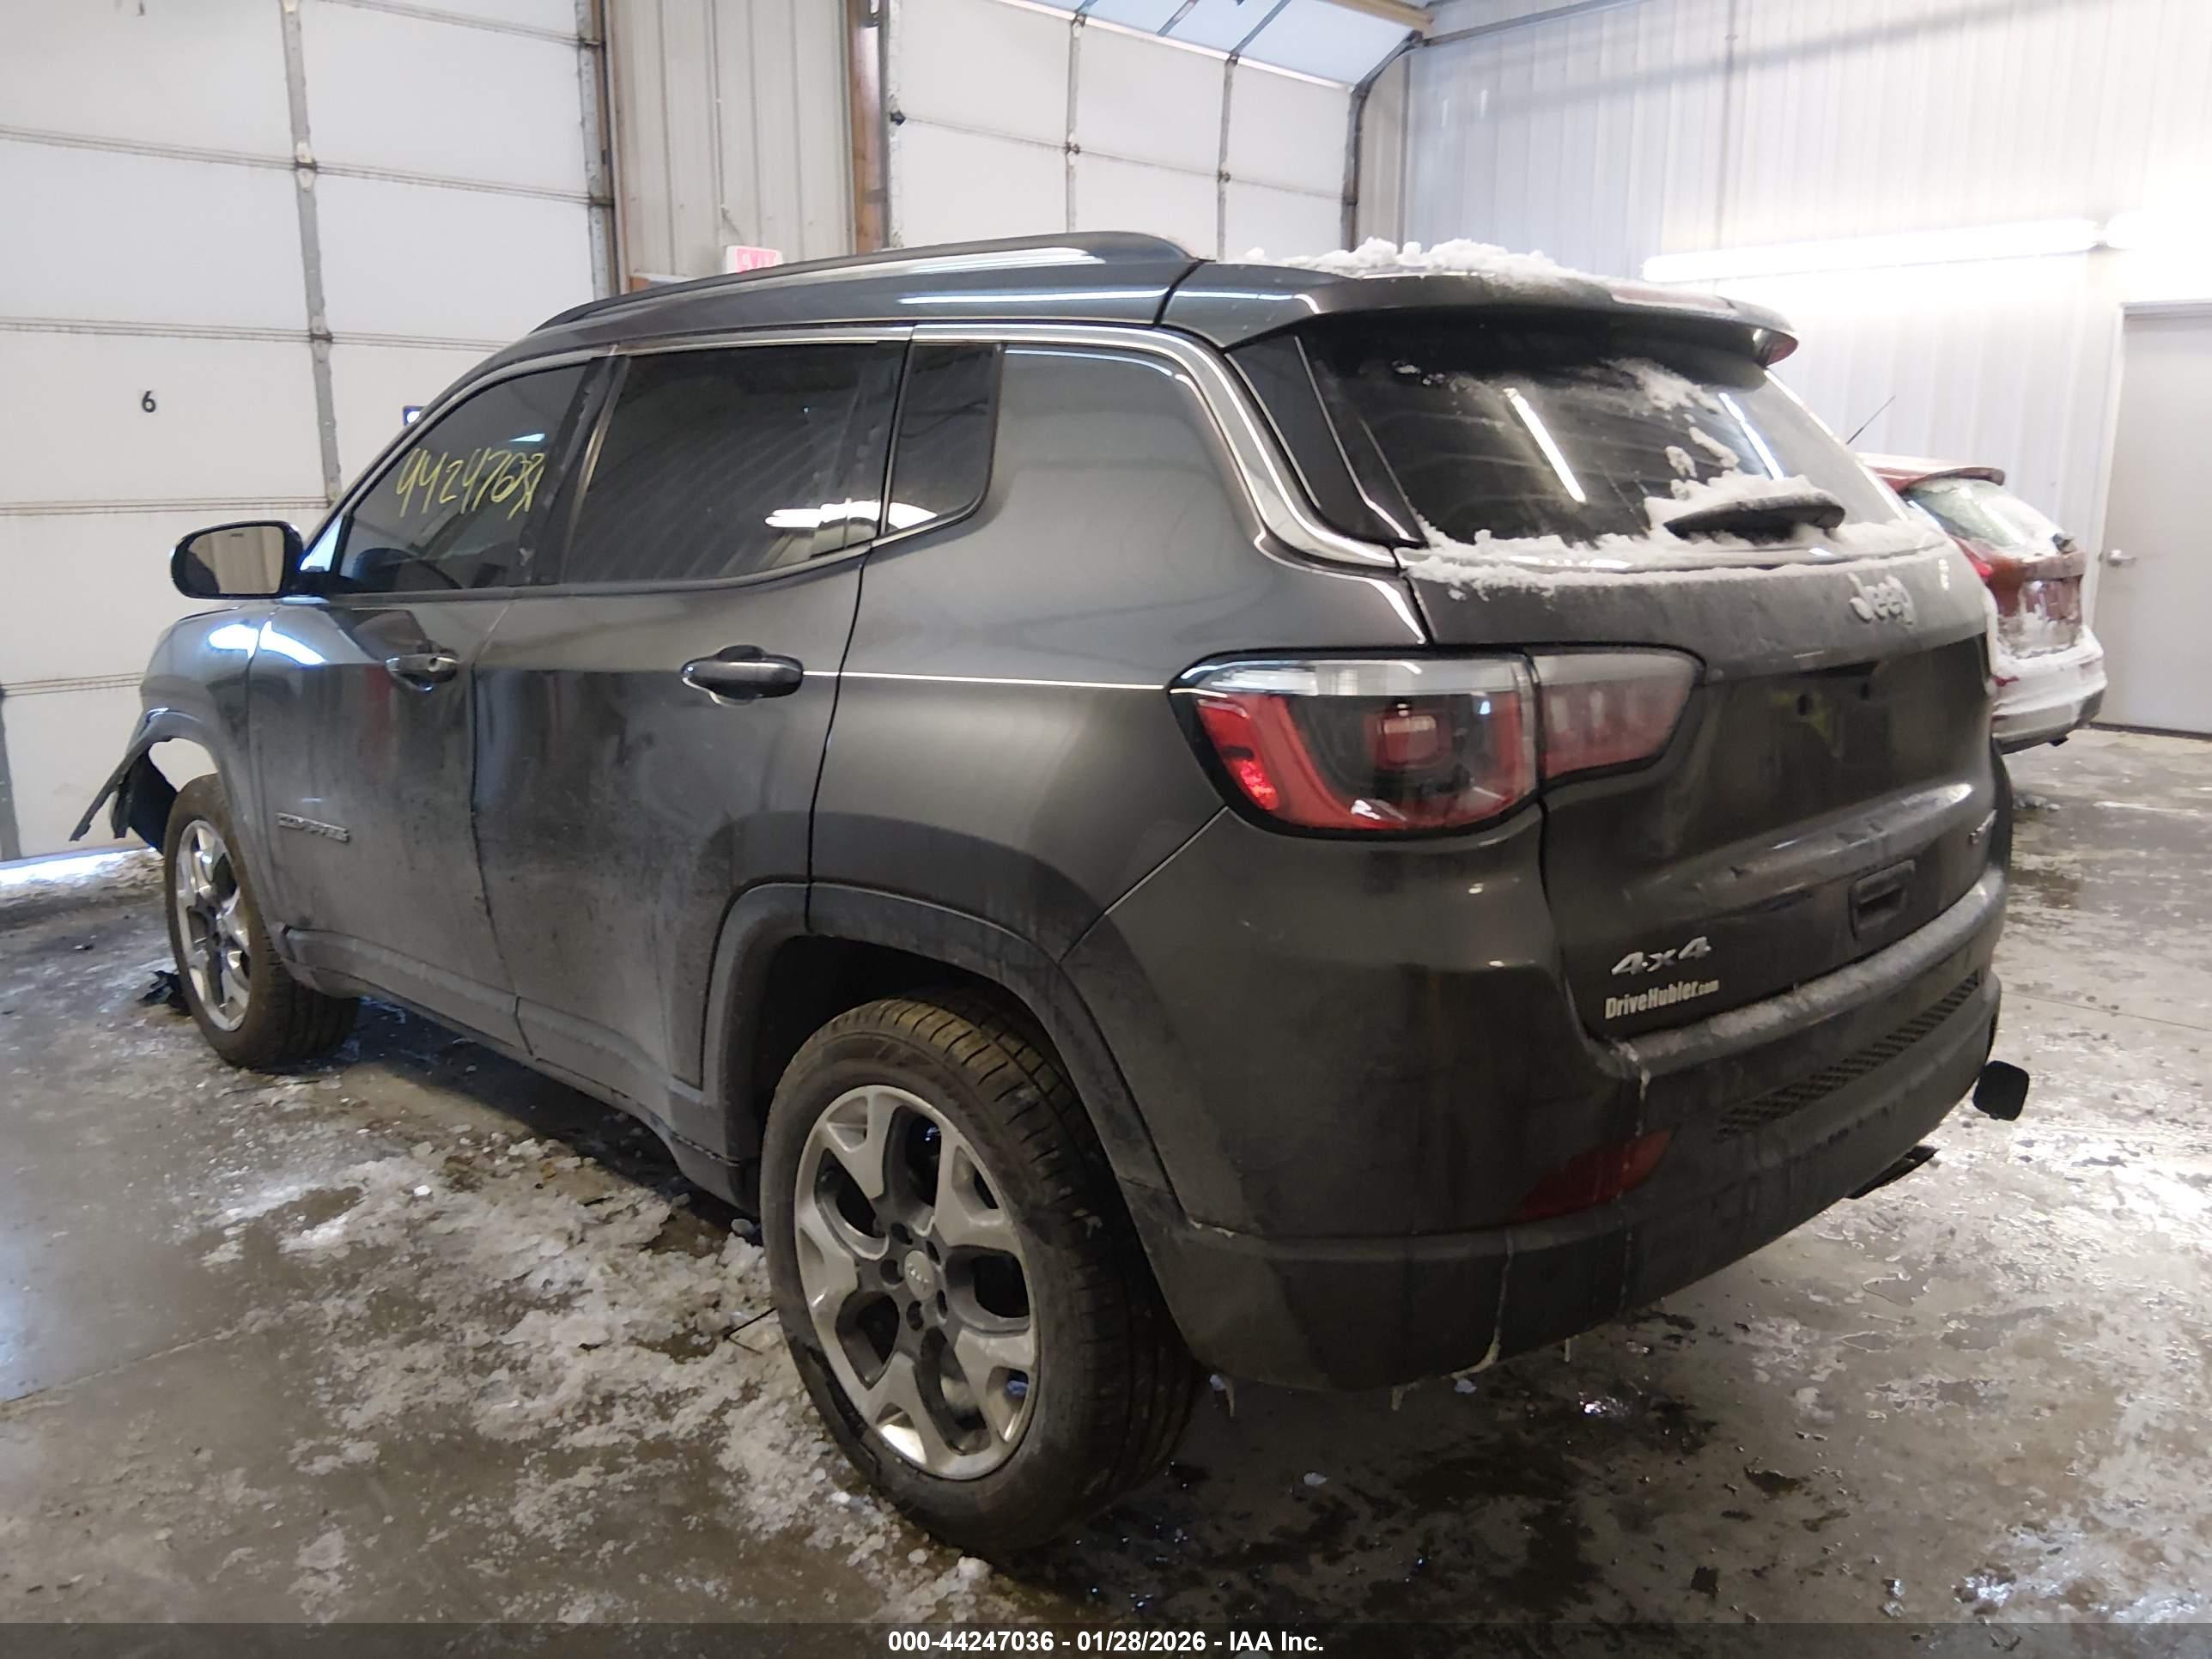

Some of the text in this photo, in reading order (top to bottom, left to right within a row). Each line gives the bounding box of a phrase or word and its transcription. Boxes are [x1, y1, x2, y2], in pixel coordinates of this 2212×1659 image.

[141, 391, 156, 413] 6
[1847, 571, 1915, 633] Jeep
[1611, 935, 1711, 975] 4x4
[1605, 980, 1719, 1019] DriveHubler.com
